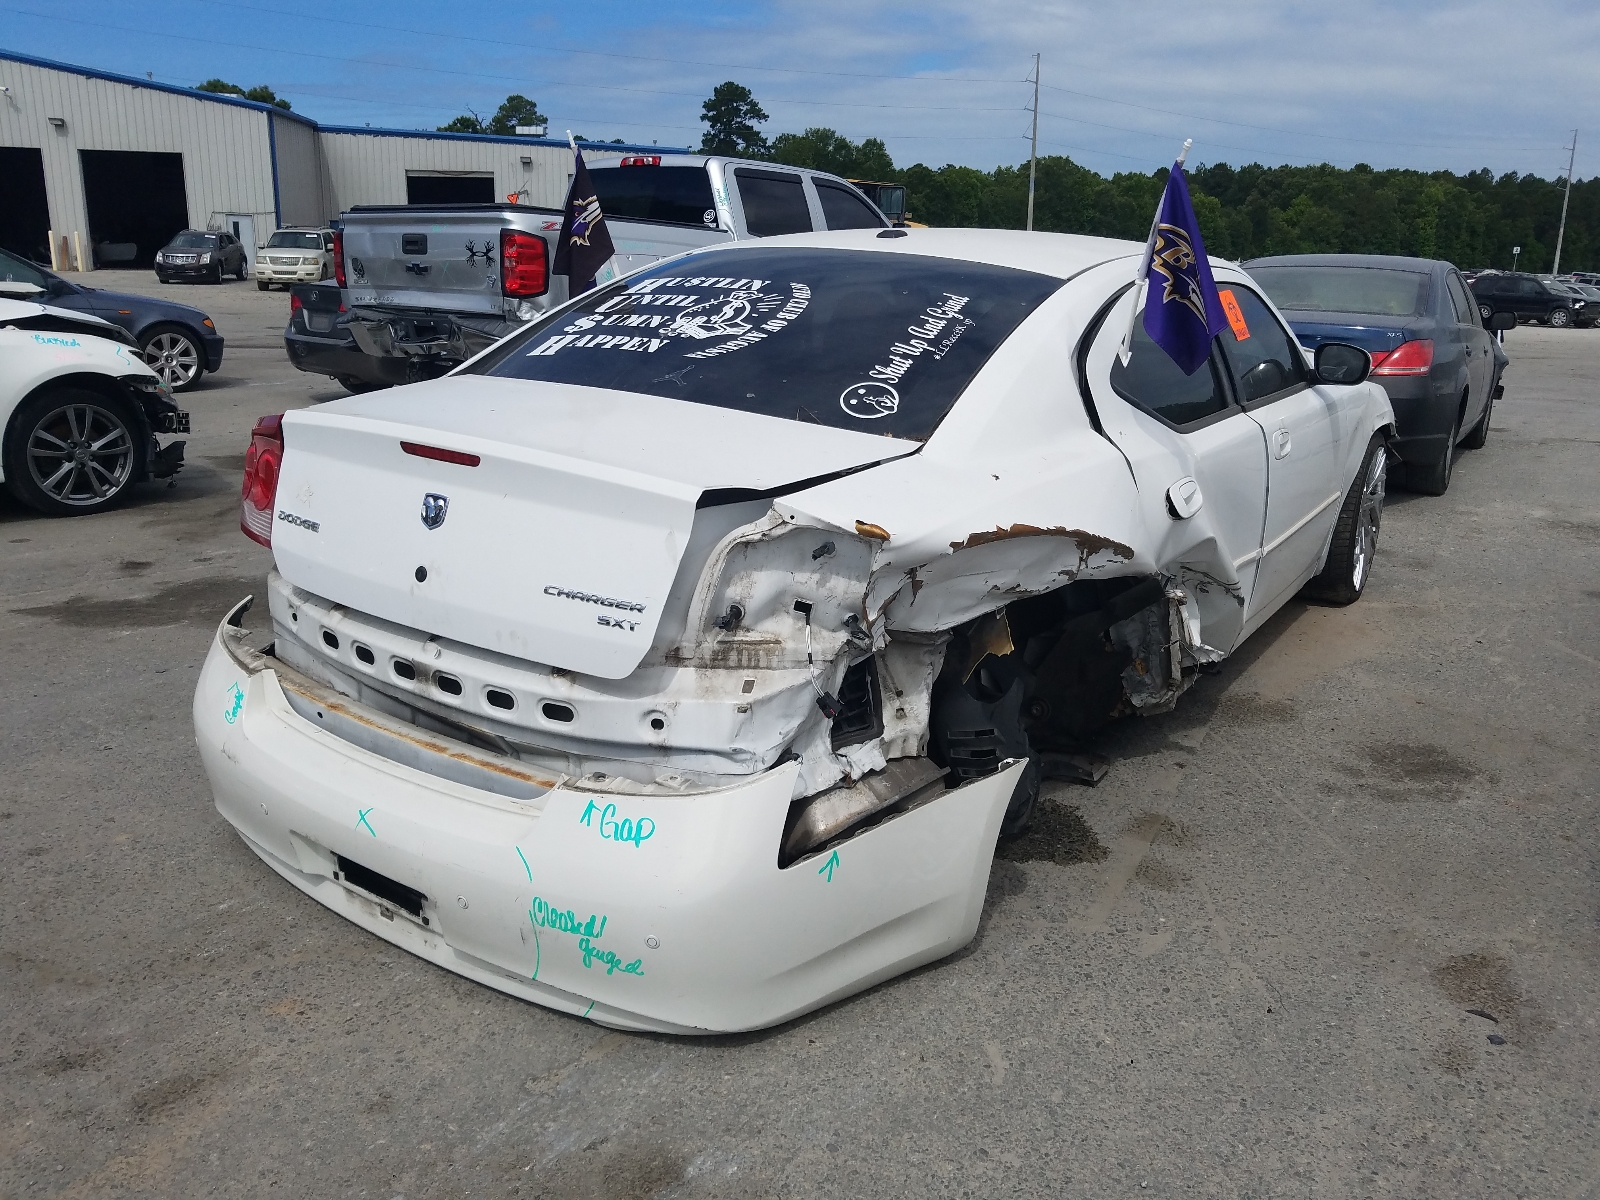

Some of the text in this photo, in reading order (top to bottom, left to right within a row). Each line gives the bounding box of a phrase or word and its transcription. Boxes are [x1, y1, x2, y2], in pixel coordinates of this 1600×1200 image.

[595, 294, 701, 313] UNTIL
[526, 334, 671, 357] HAPPEN
[869, 292, 970, 383] Shut Up And Grind
[278, 510, 320, 533] DODGE
[543, 585, 646, 614] CHARGER
[597, 614, 641, 632] SXT
[600, 803, 656, 848] Gap
